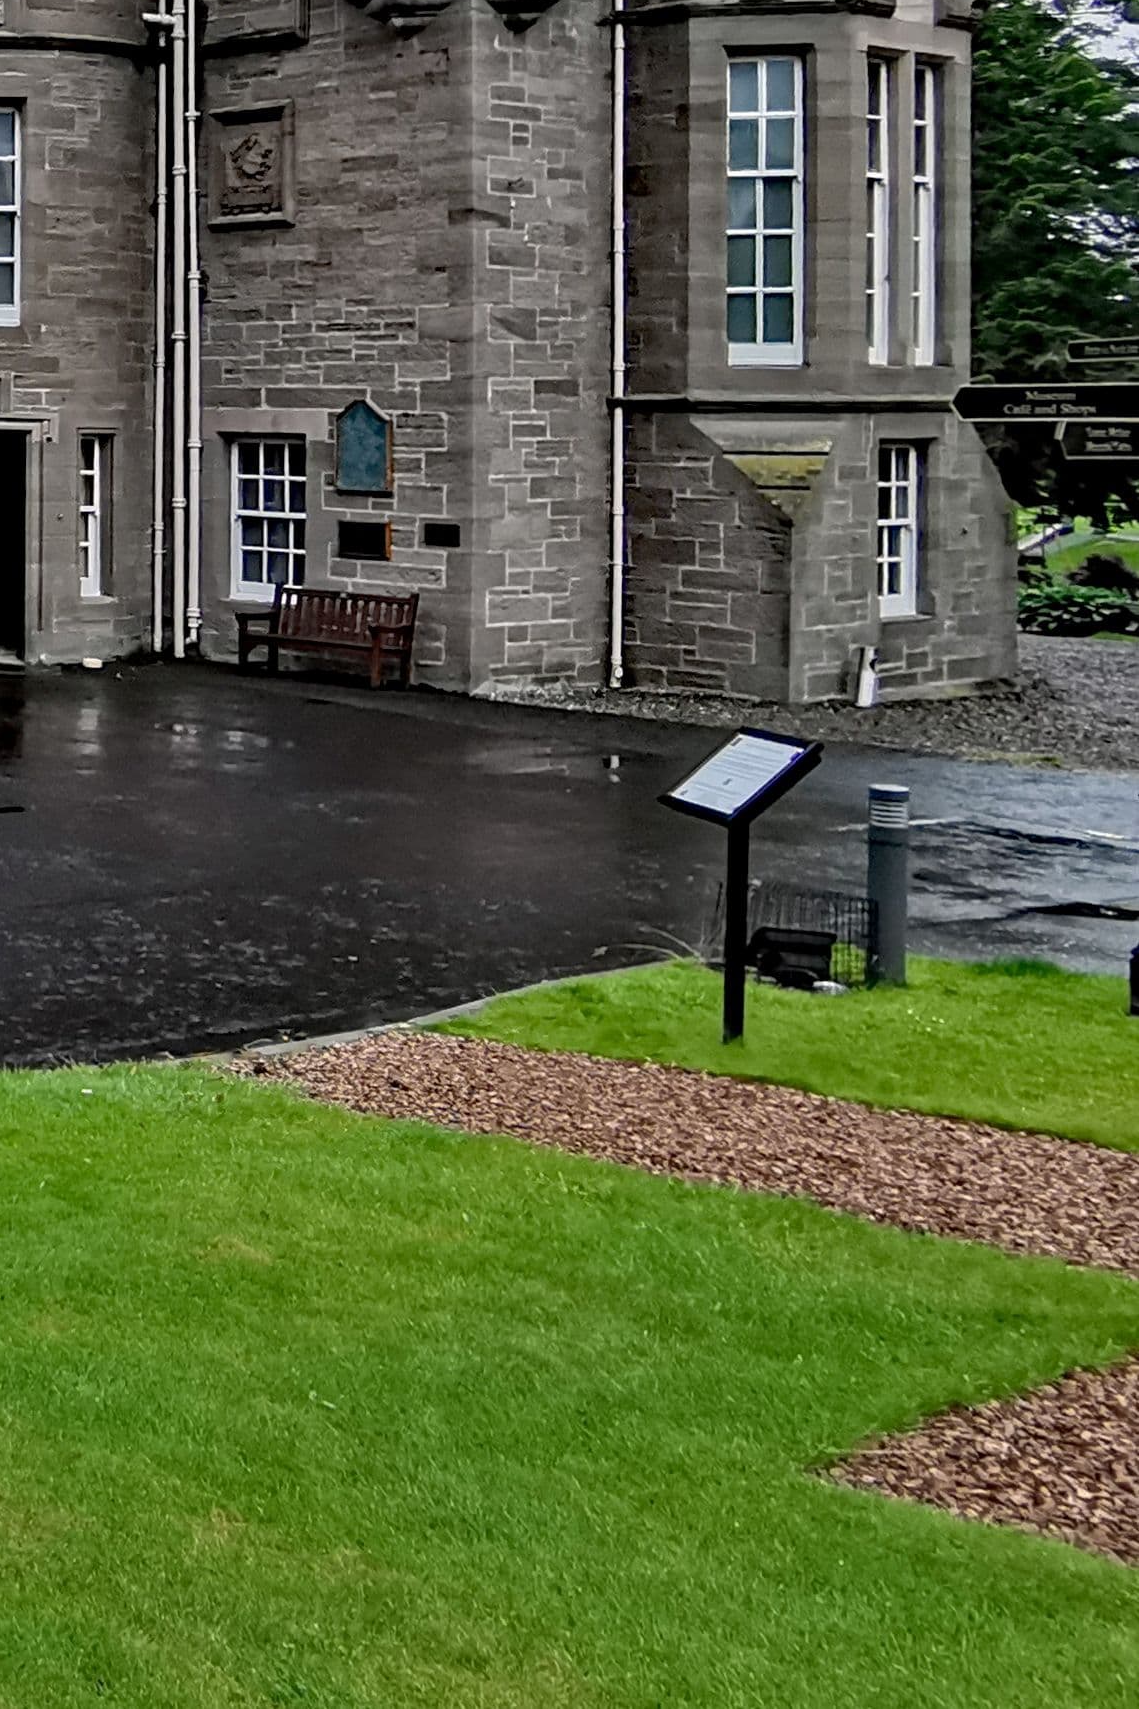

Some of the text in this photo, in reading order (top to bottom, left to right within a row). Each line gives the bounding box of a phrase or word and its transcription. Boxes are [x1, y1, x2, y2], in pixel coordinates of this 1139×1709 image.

[1024, 390, 1077, 401] Museum
[1034, 403, 1057, 415] and
[1060, 403, 1097, 416] Shops
